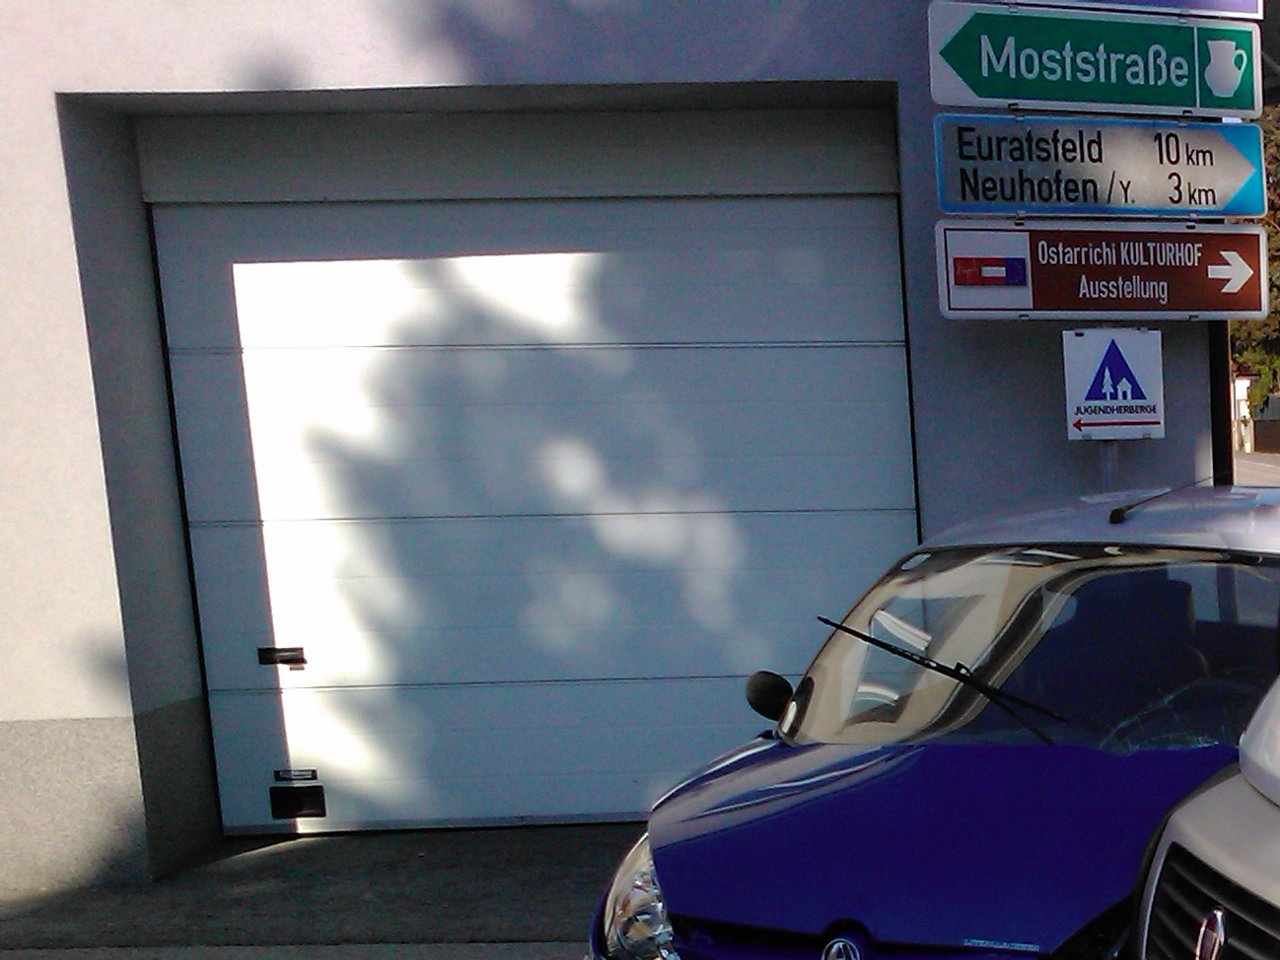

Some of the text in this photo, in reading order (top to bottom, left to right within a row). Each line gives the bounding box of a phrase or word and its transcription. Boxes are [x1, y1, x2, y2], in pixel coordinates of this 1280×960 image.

[979, 34, 1189, 88] Moststraße
[957, 126, 1214, 167] Euratsfeld 10 km
[959, 167, 1099, 204] Neuhofen
[1167, 172, 1183, 205] 3
[1187, 184, 1217, 206] km
[1037, 239, 1204, 268] Ostarrichi KULTURHOF
[1078, 274, 1169, 305] Ausstellung
[1074, 404, 1157, 416] JUGENDHERBERGE
